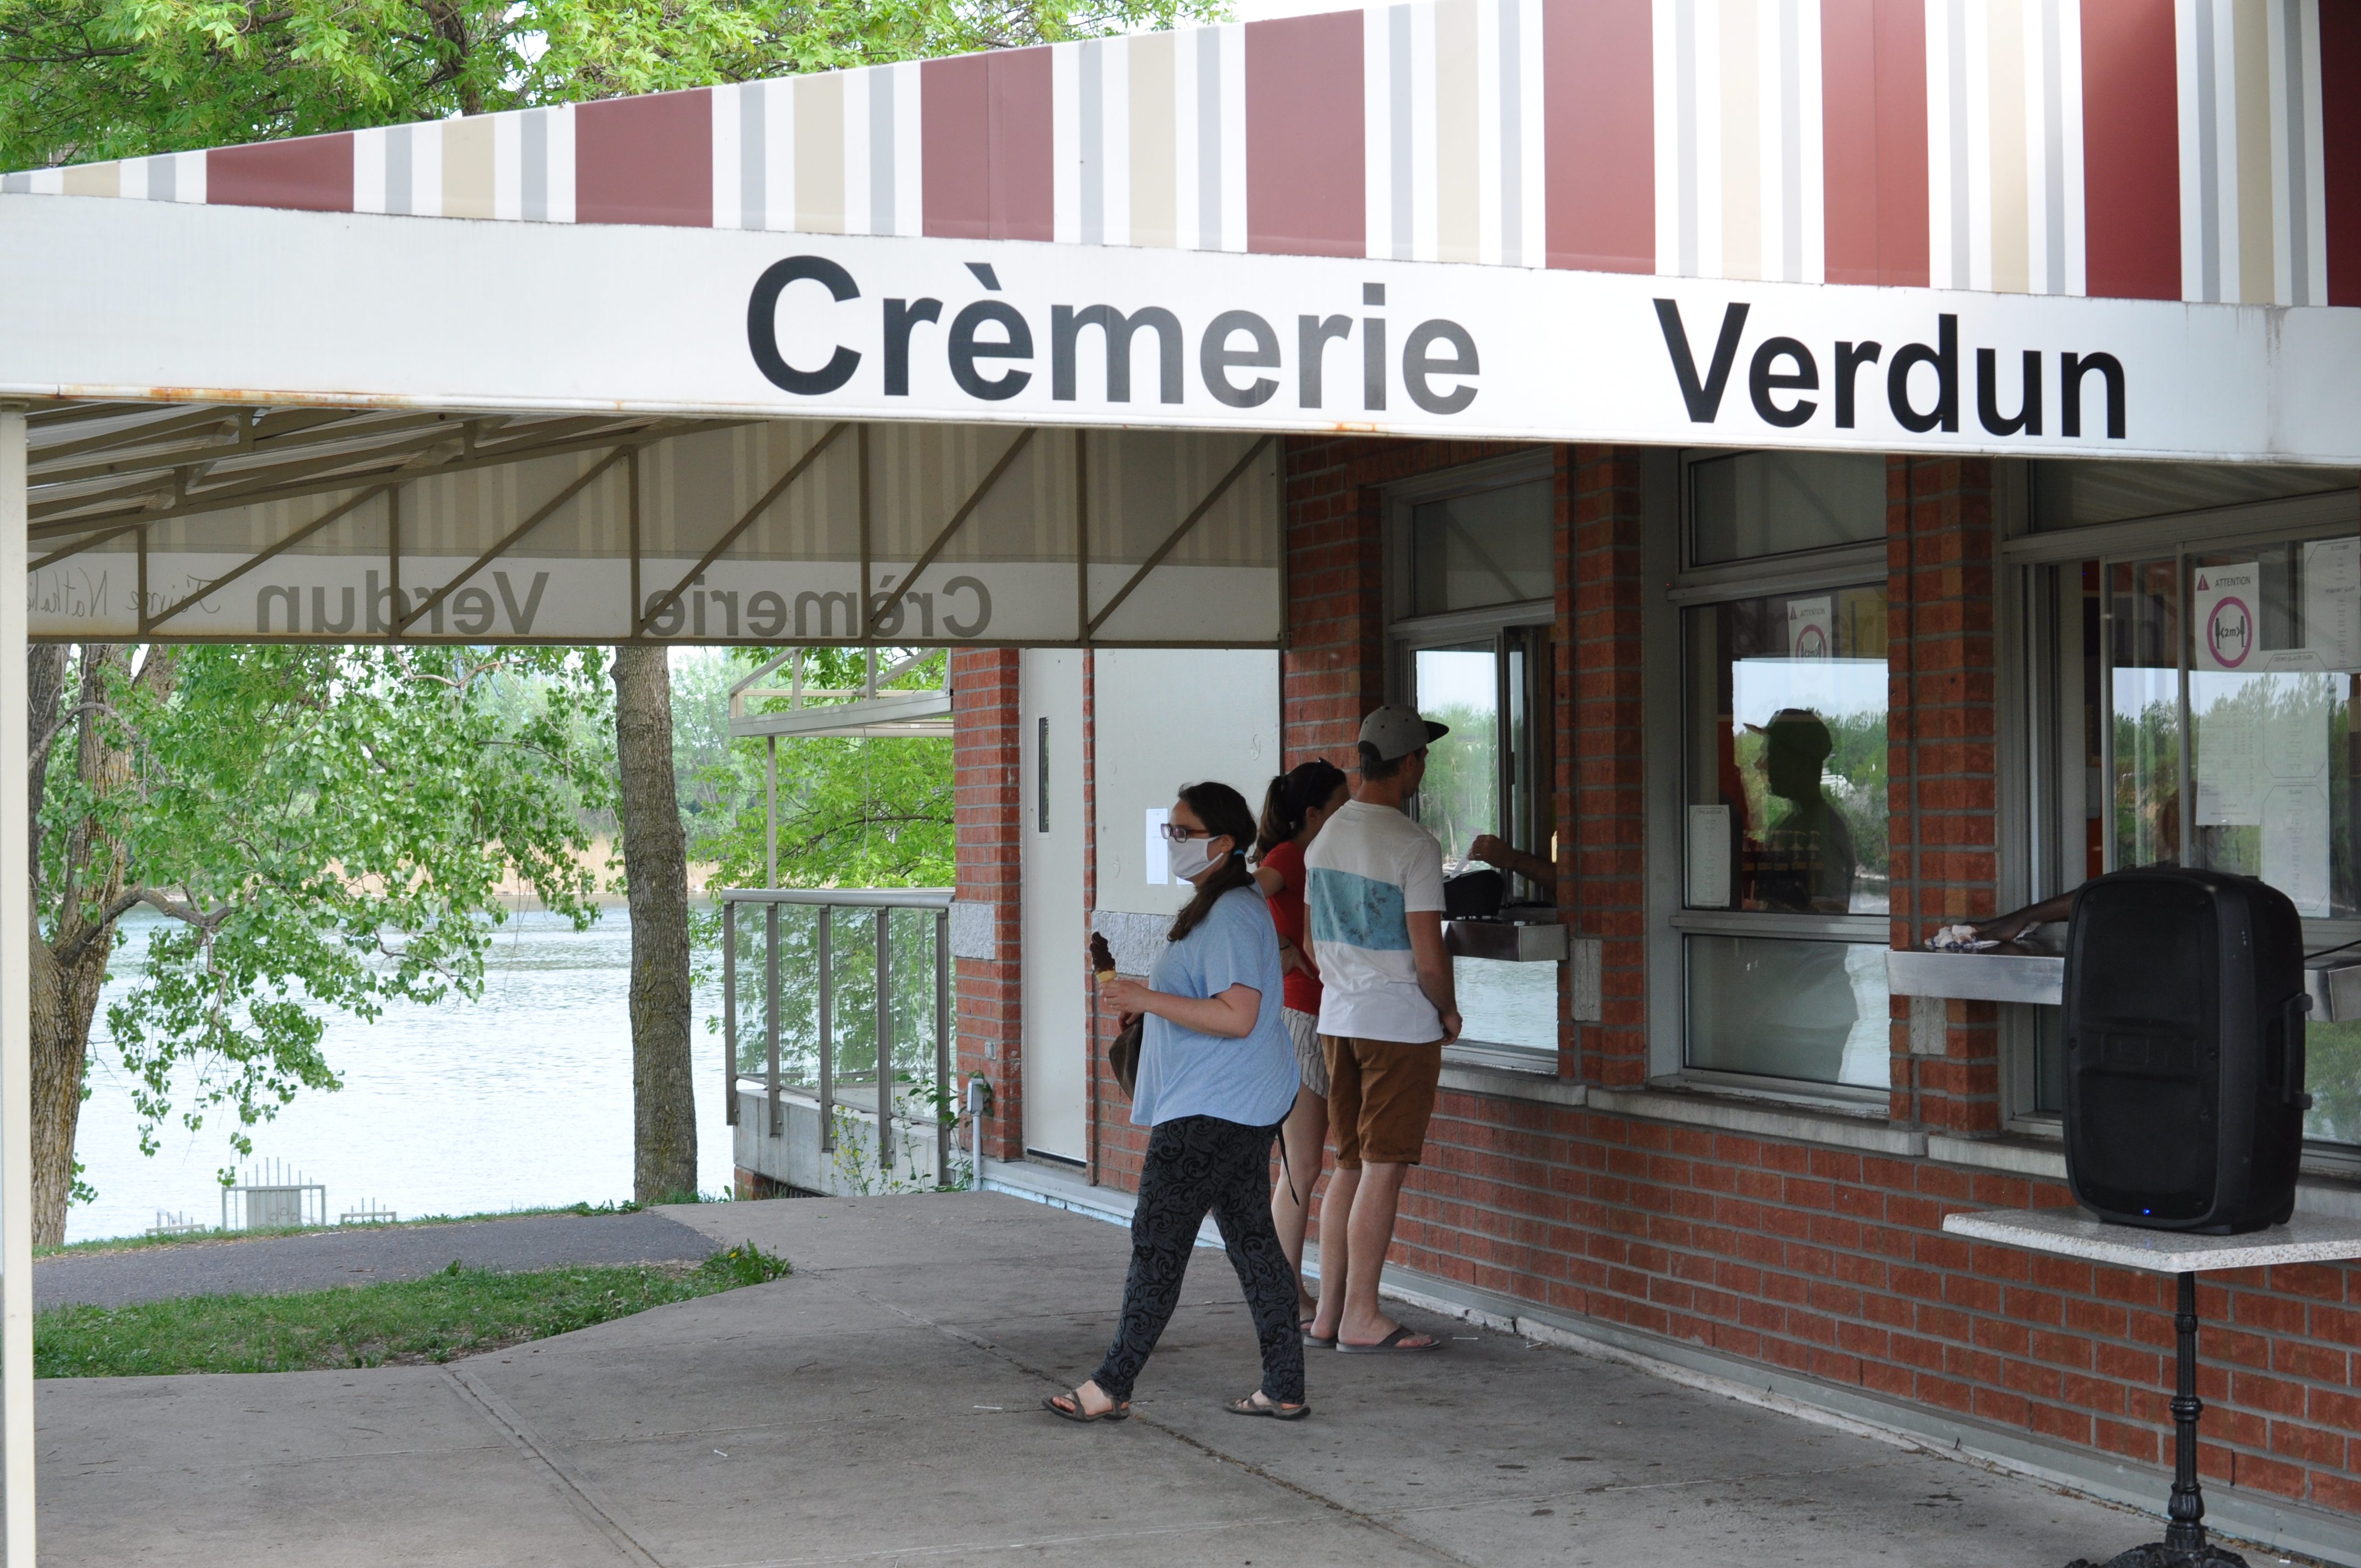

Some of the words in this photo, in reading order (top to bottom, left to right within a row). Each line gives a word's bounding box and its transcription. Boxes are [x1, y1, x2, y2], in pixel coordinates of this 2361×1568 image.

[747, 255, 1481, 415] Crèmerie
[1652, 298, 2126, 440] Verdun
[2215, 576, 2250, 587] ATTENTION
[1800, 607, 1825, 617] ATTENTION
